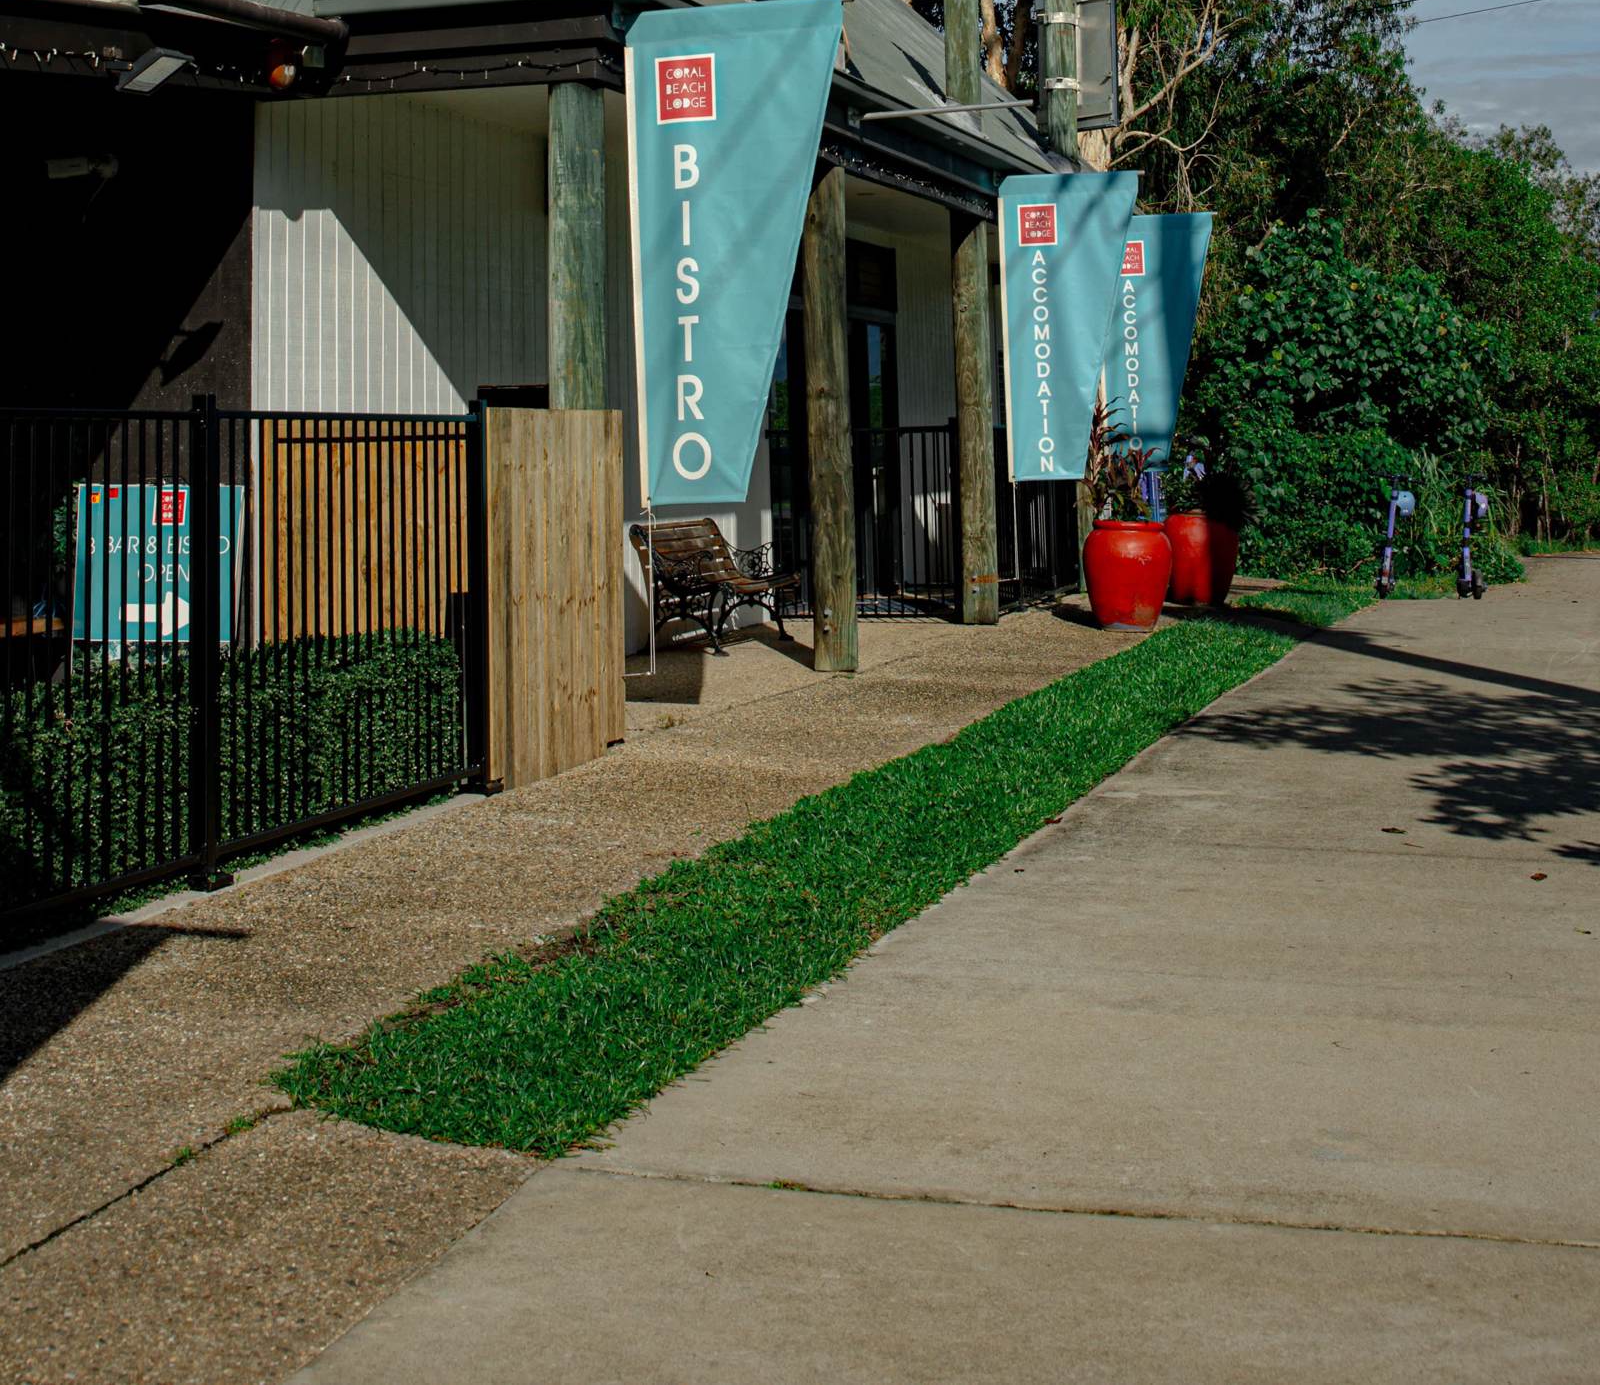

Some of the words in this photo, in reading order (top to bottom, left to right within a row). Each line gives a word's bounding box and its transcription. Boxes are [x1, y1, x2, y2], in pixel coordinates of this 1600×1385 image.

[665, 66, 705, 80] CORAL
[665, 81, 706, 95] BEACH
[666, 96, 706, 110] LODGE
[1024, 210, 1051, 219] CORAL
[1024, 220, 1051, 229] BEACH
[1025, 229, 1052, 238] LODGE
[672, 144, 712, 480] BISTRO
[1031, 250, 1055, 472] ACCOMODATION
[1122, 279, 1143, 451] ACCOMODATIO
[146, 536, 157, 554] &
[137, 563, 190, 582] OPEN
